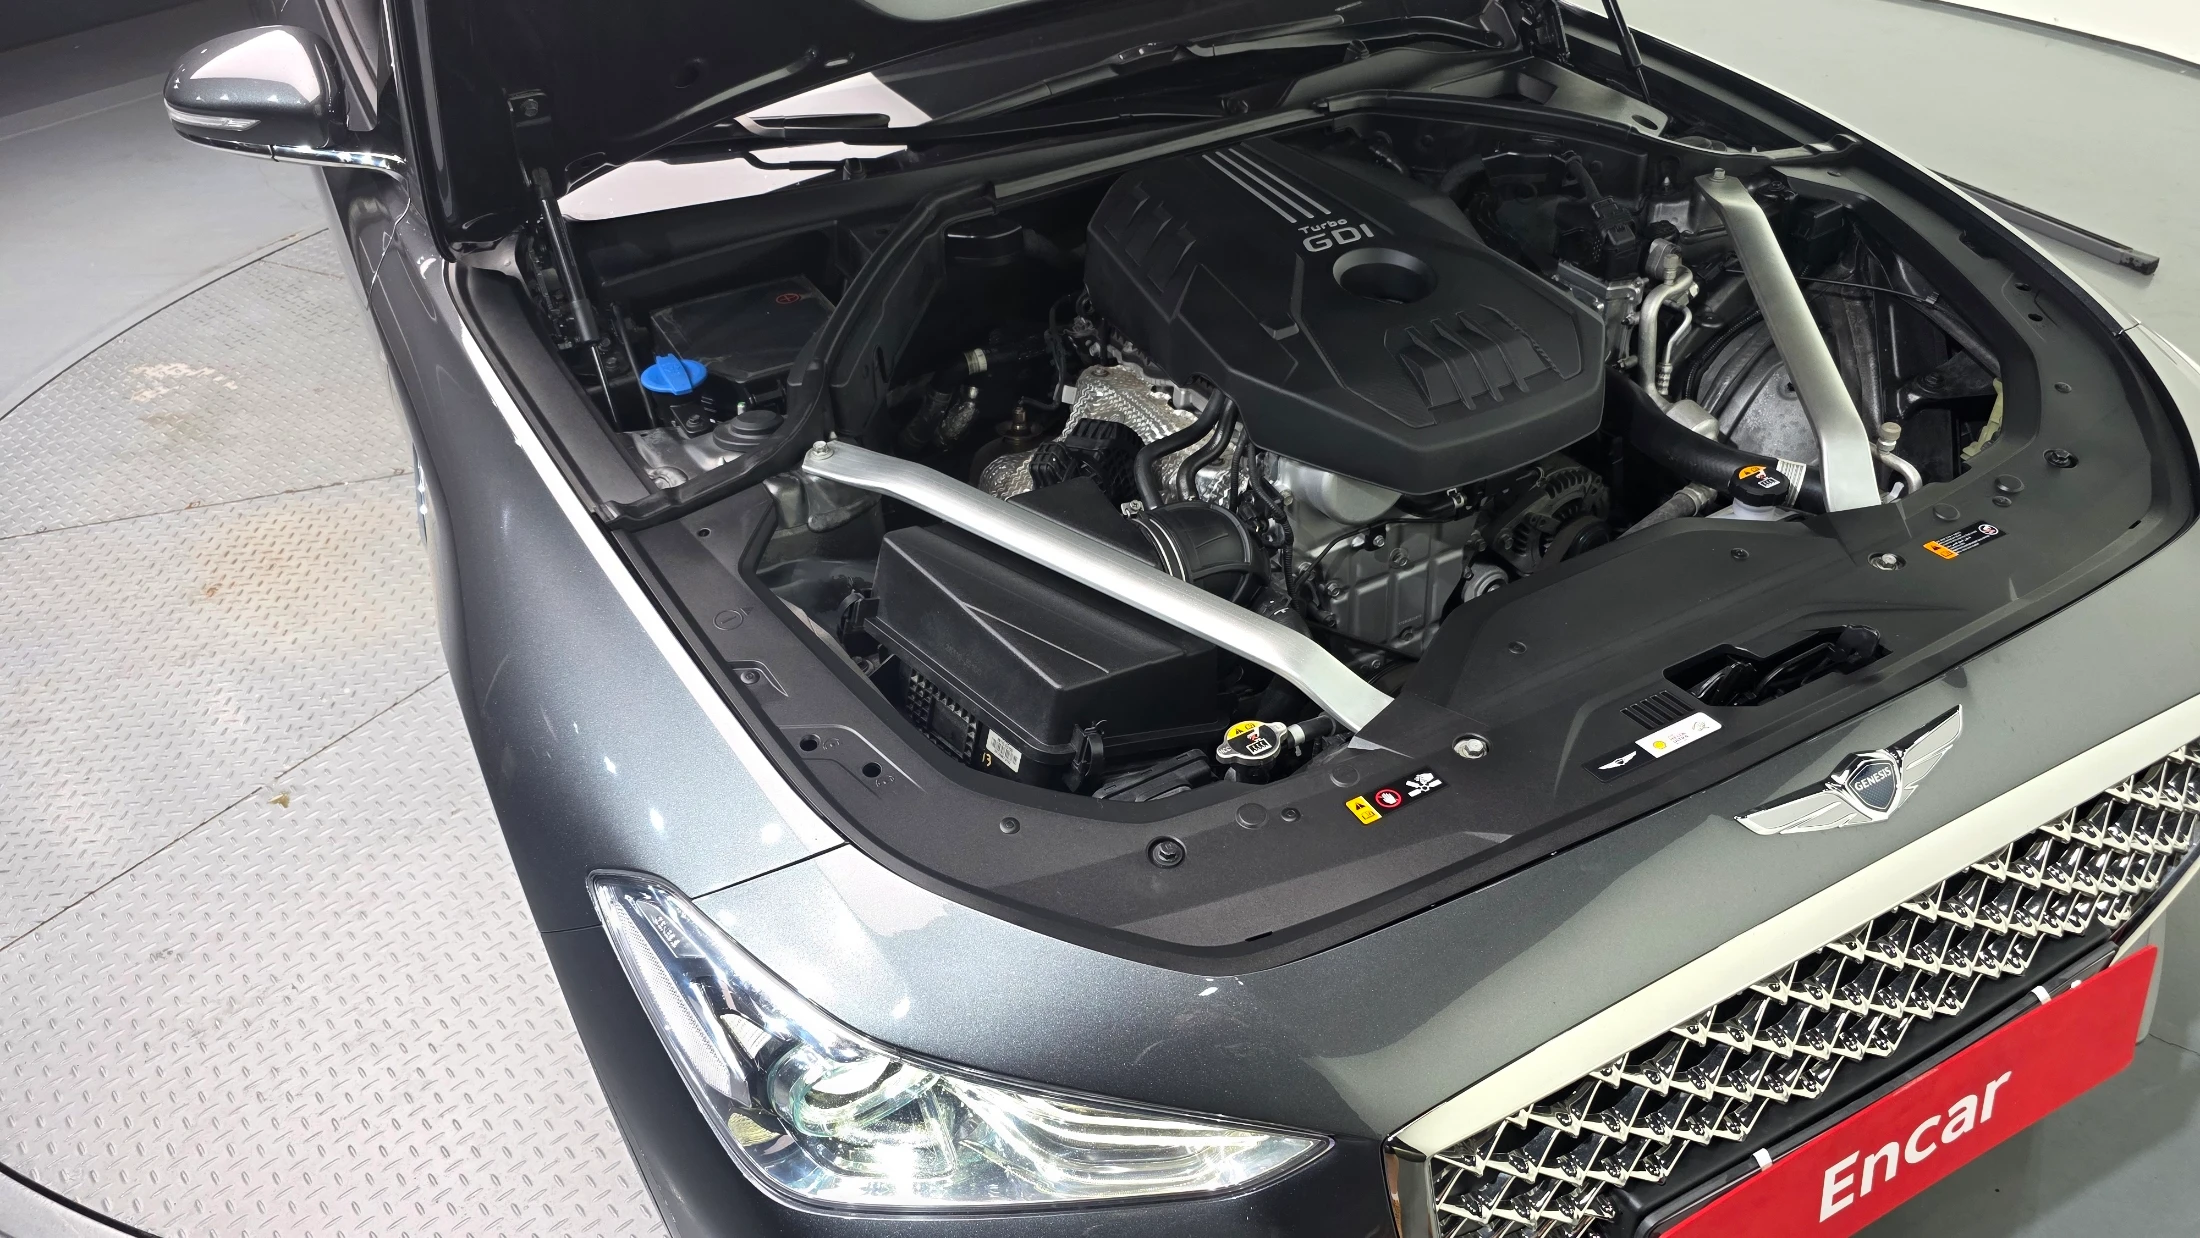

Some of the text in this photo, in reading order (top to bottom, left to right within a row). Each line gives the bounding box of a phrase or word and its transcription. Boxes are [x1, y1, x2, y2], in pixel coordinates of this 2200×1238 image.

[1298, 218, 1348, 234] Turbo
[1302, 223, 1375, 252] GDI
[1854, 766, 1892, 791] GENESIS
[1819, 1071, 2012, 1223] Encar
